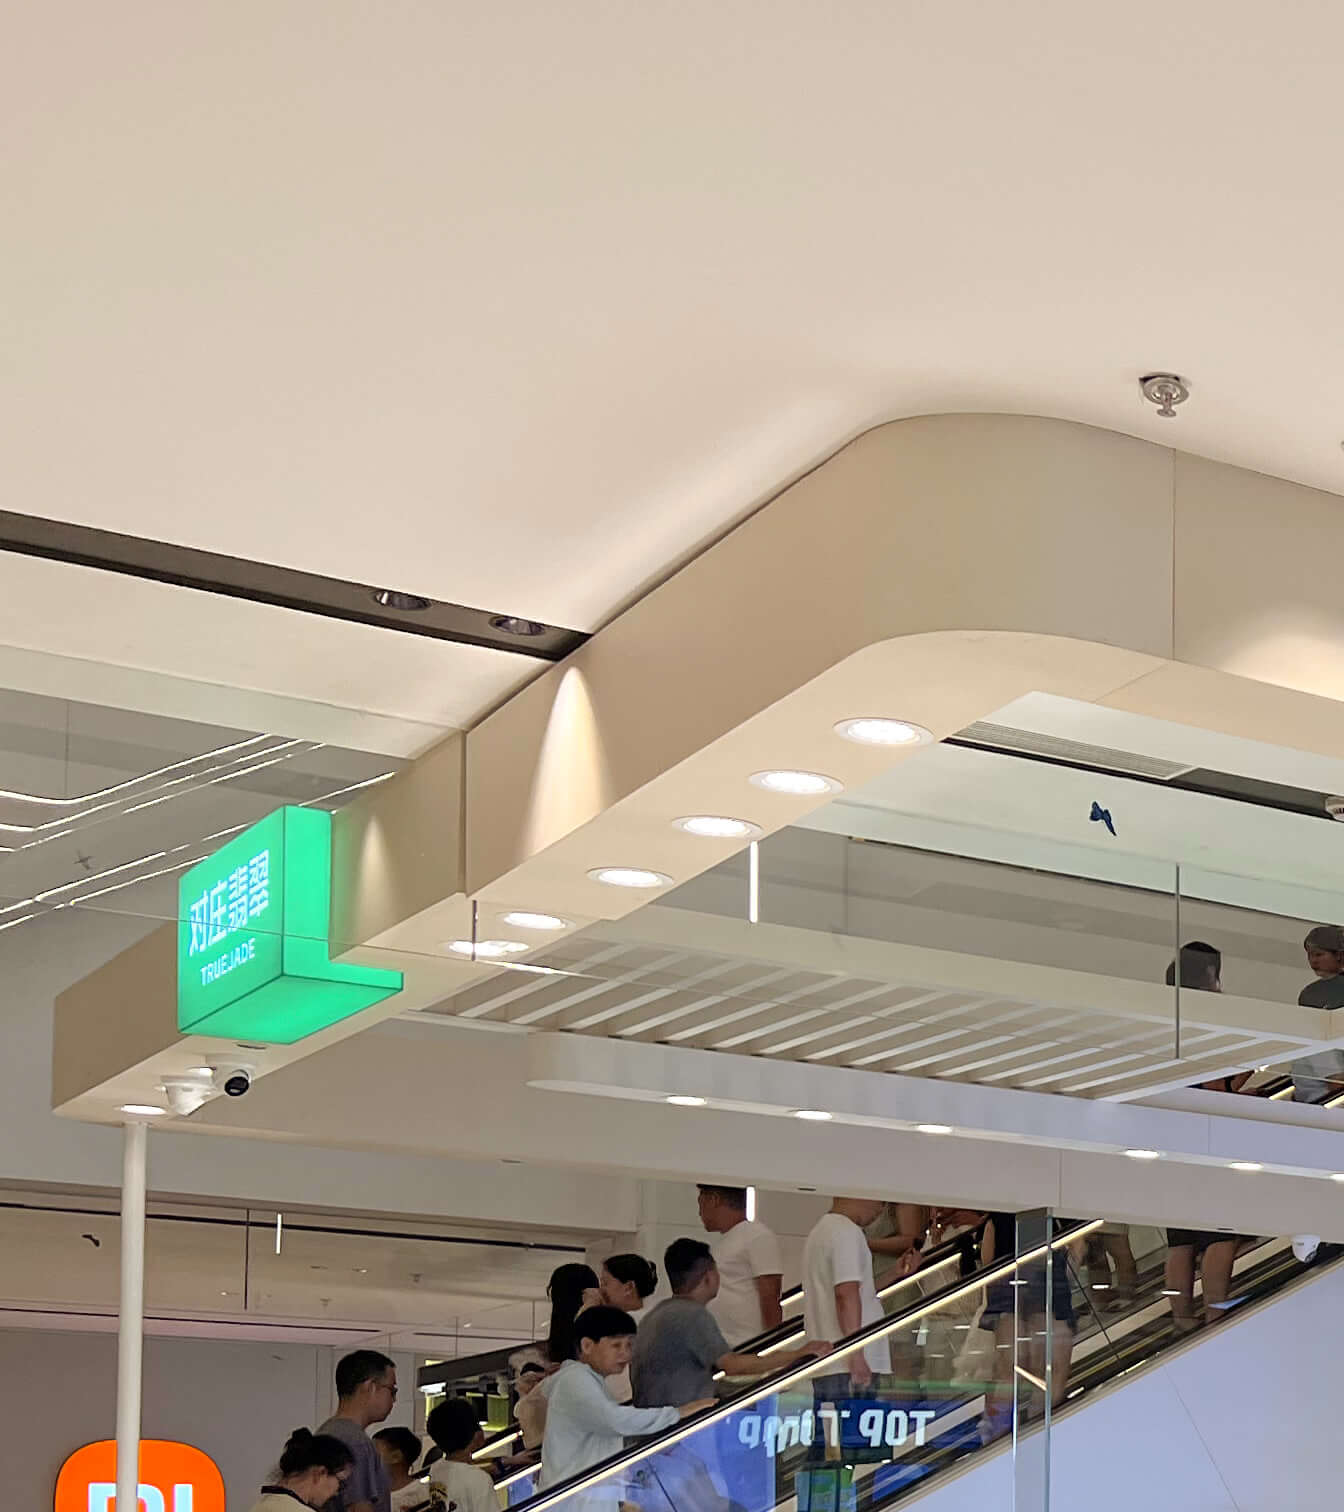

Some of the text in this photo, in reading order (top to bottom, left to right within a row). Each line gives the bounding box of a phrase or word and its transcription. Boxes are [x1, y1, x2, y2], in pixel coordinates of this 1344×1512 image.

[189, 849, 270, 957] 对庄翡翠
[200, 937, 256, 986] TRUEJADE
